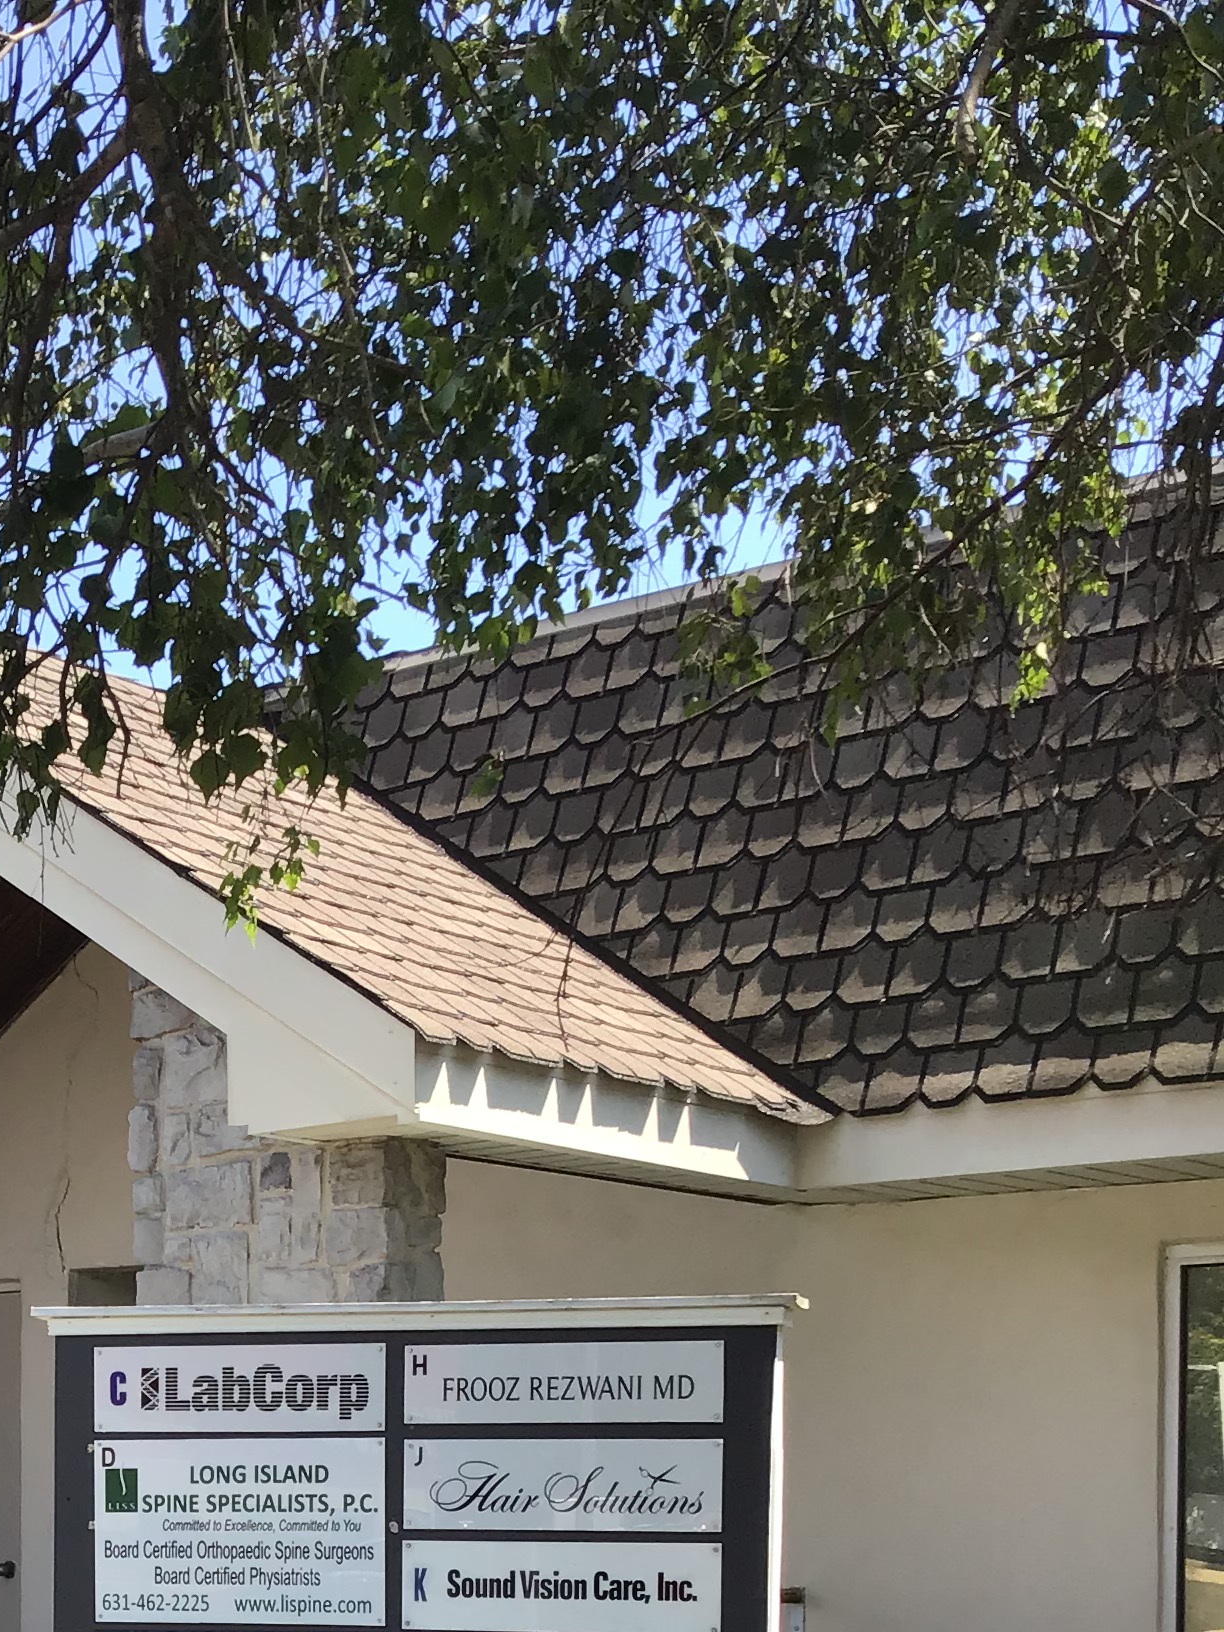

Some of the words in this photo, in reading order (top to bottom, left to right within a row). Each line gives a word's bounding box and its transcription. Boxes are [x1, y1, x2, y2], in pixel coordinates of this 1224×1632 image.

[412, 1355, 427, 1376] H
[109, 1371, 127, 1406] C
[165, 1364, 370, 1419] LabCorp
[443, 1377, 520, 1401] FROOZ
[530, 1375, 642, 1401] REZWANI
[653, 1375, 695, 1400] MD
[102, 1448, 116, 1467] D
[414, 1447, 423, 1466] J
[190, 1465, 246, 1484] LONG
[254, 1464, 330, 1484] ISLAND
[429, 1460, 539, 1513] Hair
[544, 1466, 703, 1515] Solutions
[108, 1502, 136, 1510] LISS
[142, 1494, 199, 1513] SPINE
[206, 1493, 336, 1516] SPECIALISTS,
[343, 1493, 379, 1514] P.C.
[162, 1519, 211, 1532] Committed
[213, 1520, 222, 1532] to
[224, 1519, 276, 1534] Excellence,
[279, 1519, 328, 1533] Committed
[330, 1520, 341, 1533] to
[343, 1519, 361, 1533] You
[104, 1541, 139, 1559] Board
[143, 1540, 194, 1560] Certified
[196, 1540, 271, 1565] Orthopaedic
[275, 1540, 310, 1565] Spine
[314, 1541, 374, 1565] Surgeons
[154, 1566, 190, 1585] Board
[194, 1566, 245, 1586] Certified
[249, 1566, 321, 1591] Physiatrists
[413, 1568, 428, 1602] K
[447, 1569, 516, 1599] Sound
[520, 1570, 587, 1600] Vision
[594, 1571, 651, 1604] Care,
[657, 1573, 698, 1602] Inc.
[102, 1594, 209, 1612] 631-462-2225
[235, 1594, 372, 1617] www.lispine.com
